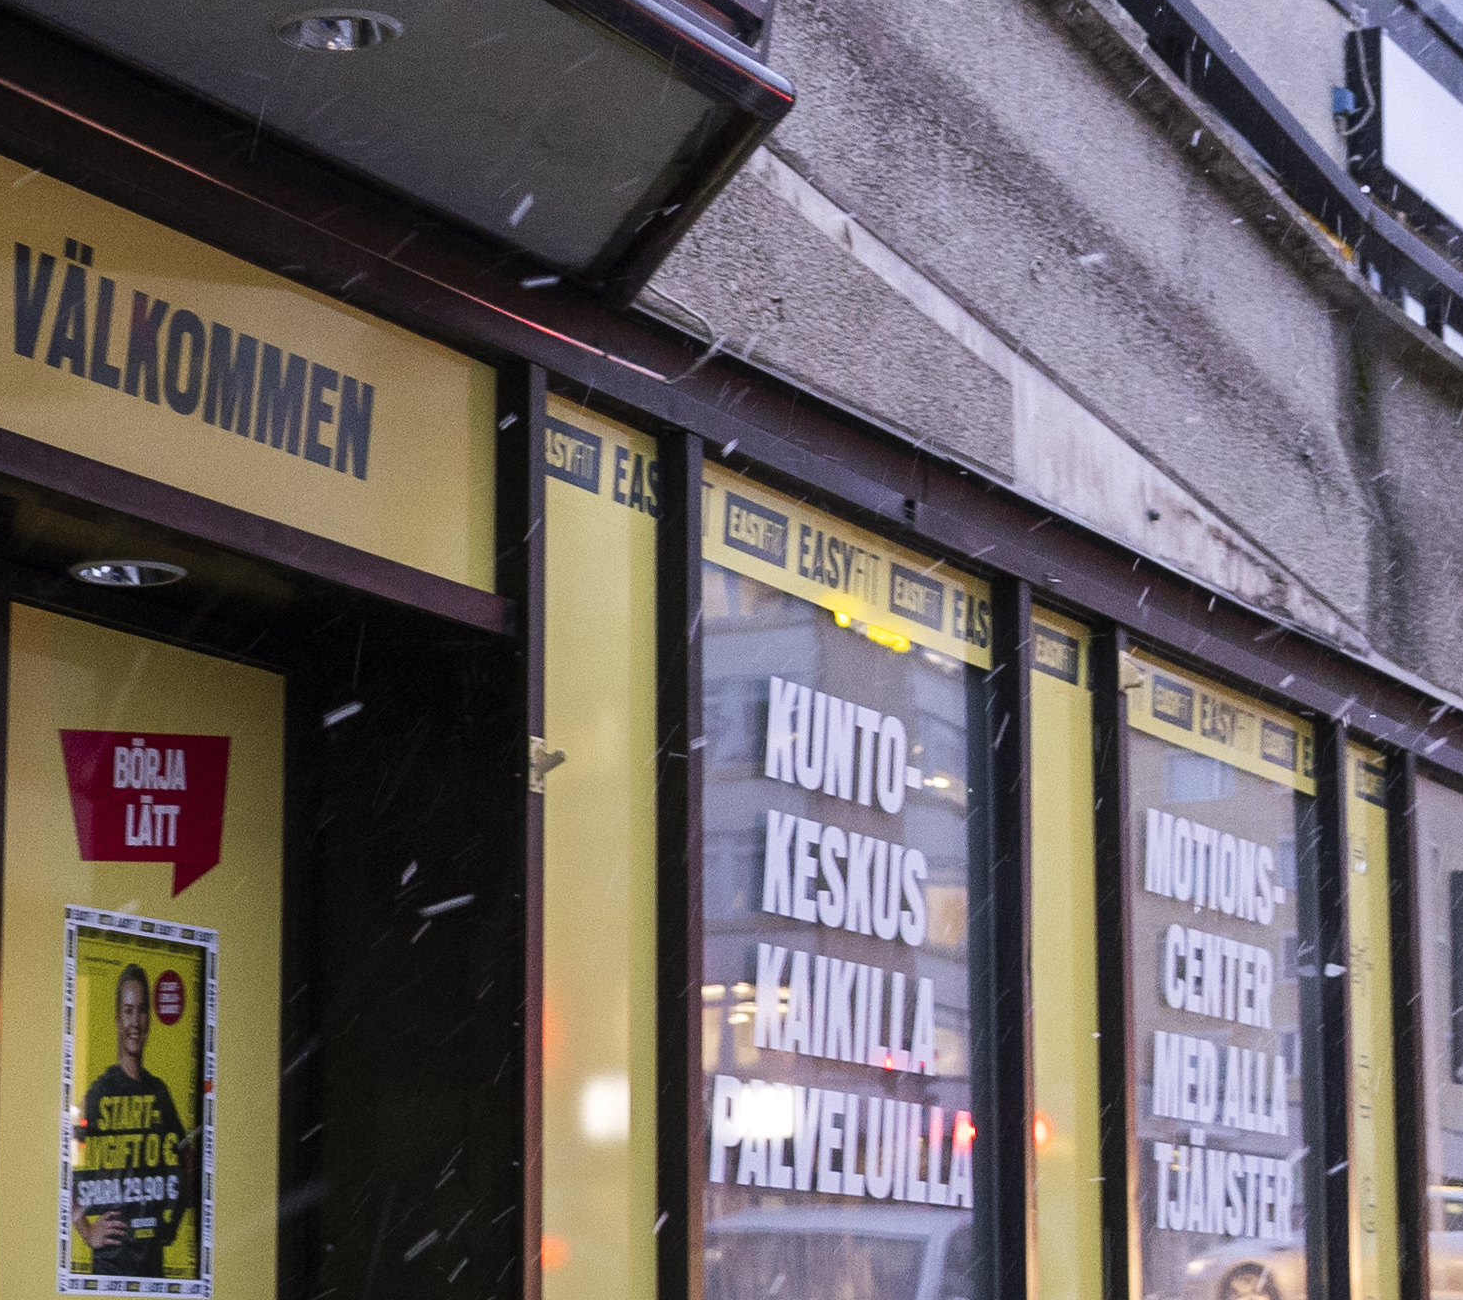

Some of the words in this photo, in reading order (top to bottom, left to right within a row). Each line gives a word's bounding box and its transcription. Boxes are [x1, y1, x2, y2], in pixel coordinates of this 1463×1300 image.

[12, 236, 375, 481] VÄLKOMMEN
[729, 505, 784, 558] EASYFIT
[797, 523, 881, 607] EASYFIT
[113, 738, 187, 792] BÖRJA
[765, 676, 923, 815] KUNTO-
[762, 809, 927, 947] KESKUS
[1144, 807, 1287, 927] MOTIONS-
[754, 942, 937, 1076] KAIKILLA
[1163, 923, 1273, 1029] CENTER
[98, 1094, 162, 1130] START-
[1152, 1030, 1219, 1126] MED
[1221, 1044, 1290, 1137] ALLA
[709, 1074, 975, 1209] PALVELUILLA
[1155, 1128, 1296, 1242] TJÄNSTER
